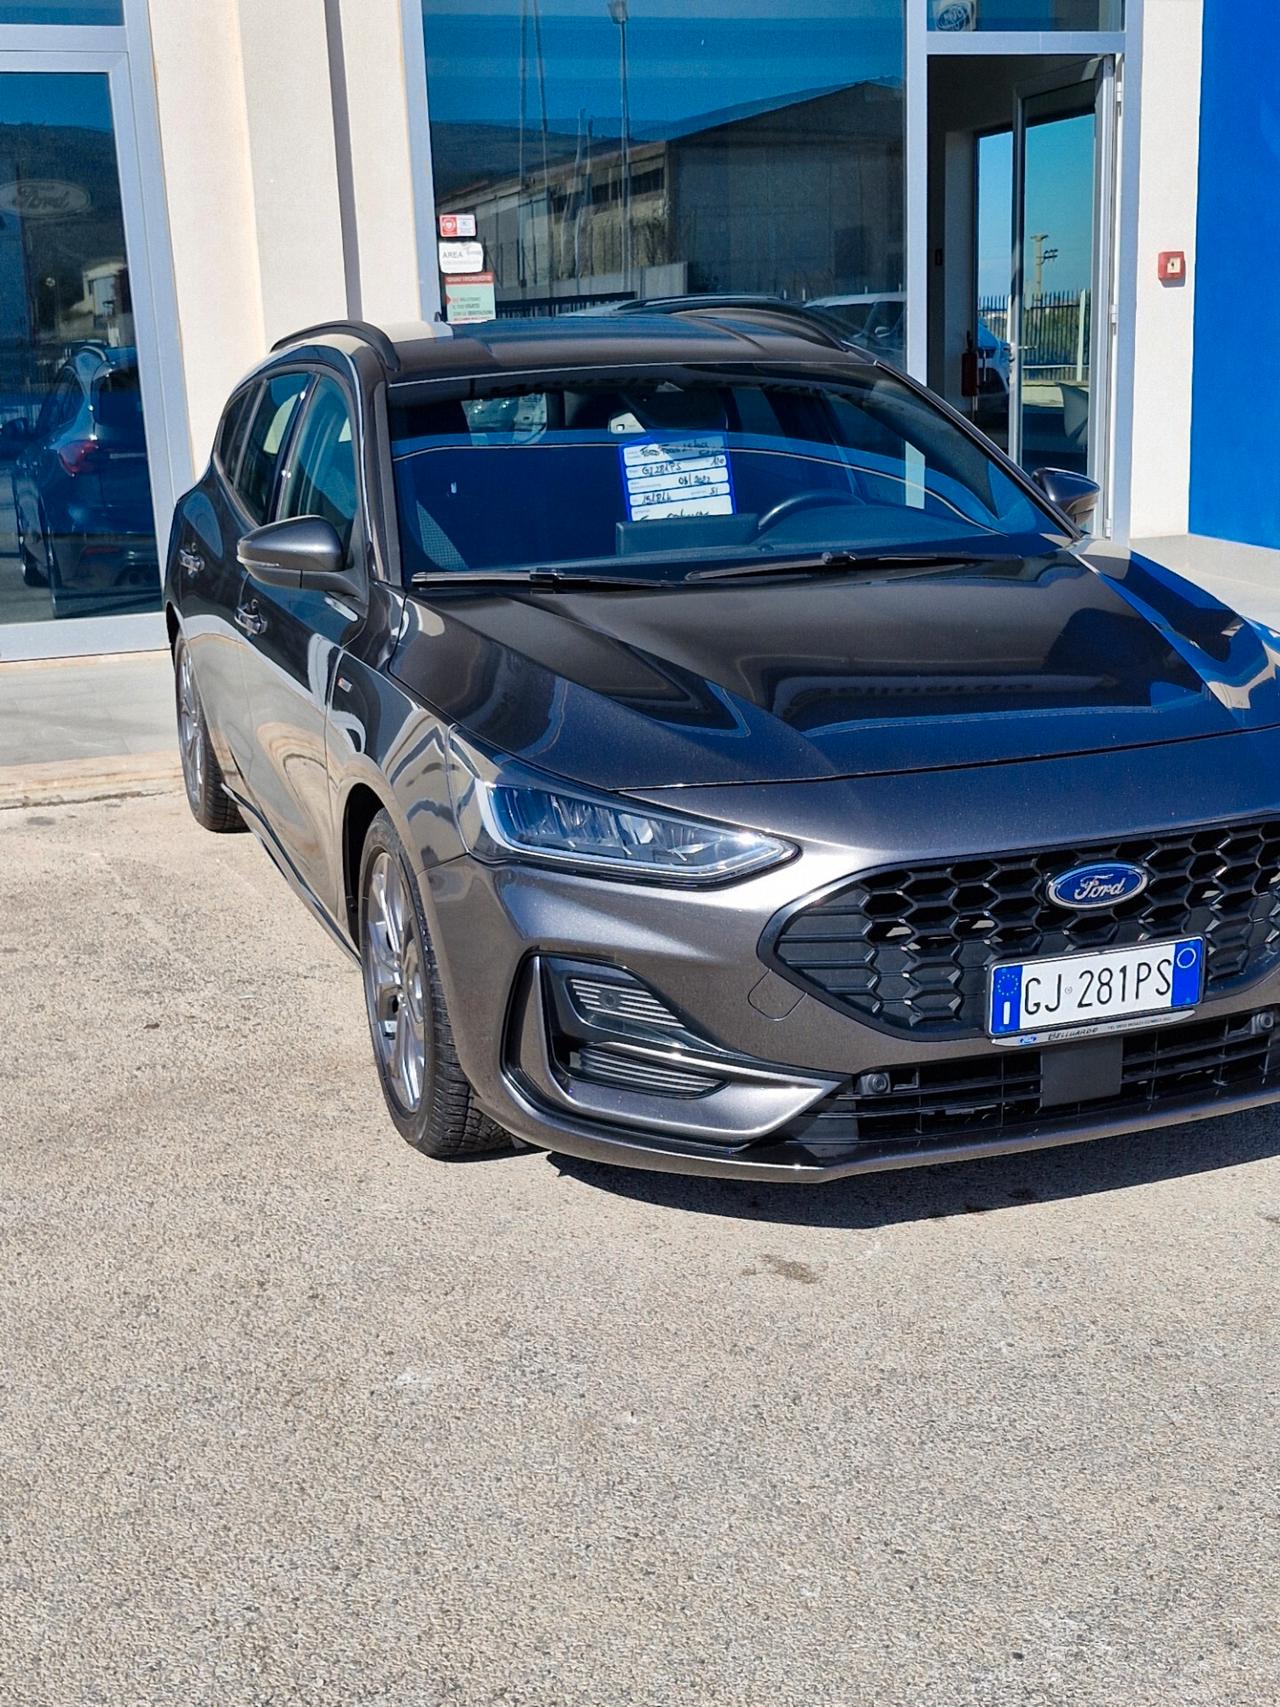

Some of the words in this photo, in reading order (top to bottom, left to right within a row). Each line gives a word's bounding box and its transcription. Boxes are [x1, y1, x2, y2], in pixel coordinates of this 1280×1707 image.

[1073, 873, 1127, 901] Ford
[1024, 973, 1062, 1015] GJ
[1076, 958, 1173, 1009] 281PS
